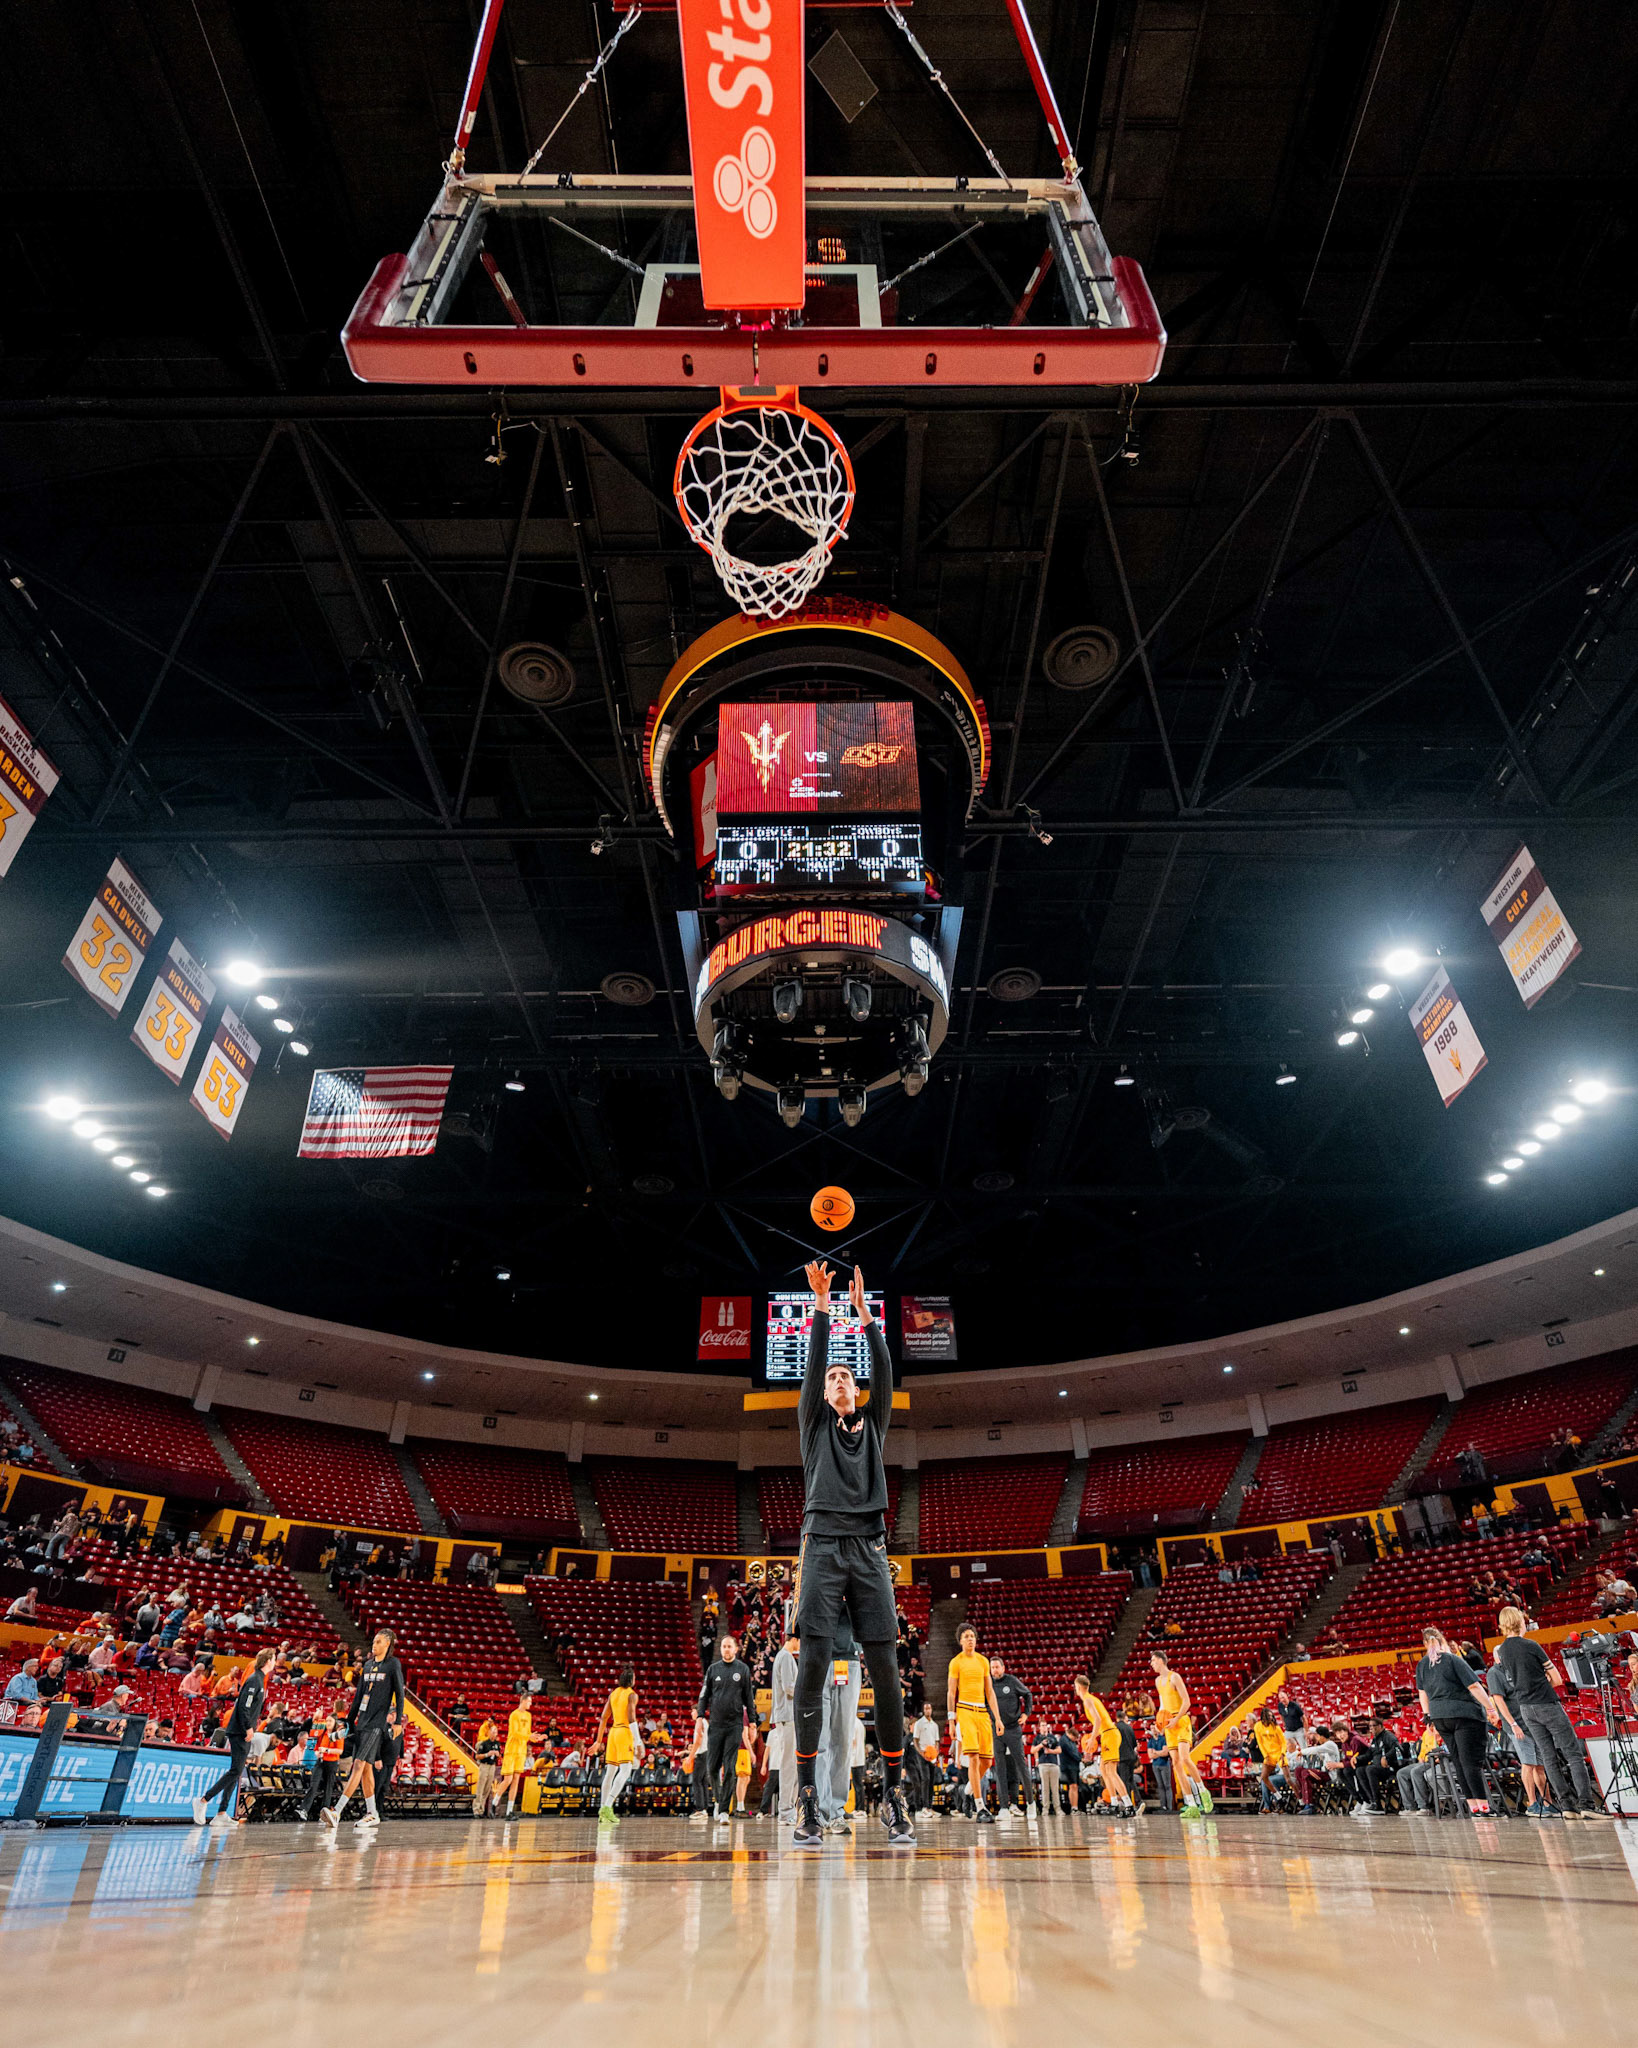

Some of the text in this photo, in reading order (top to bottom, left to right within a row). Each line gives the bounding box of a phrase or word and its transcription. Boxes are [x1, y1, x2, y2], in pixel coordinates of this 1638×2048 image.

[0, 725, 41, 780] BASKETBALL
[13, 729, 37, 760] MEN'S
[739, 841, 758, 859] 0
[787, 841, 852, 858] 21:32
[881, 838, 900, 857] 0
[118, 881, 149, 922] BASKETBALL
[129, 882, 146, 906] MEN'S
[1492, 867, 1522, 907] WRESTLING
[103, 887, 147, 947] CALDWELL
[1506, 889, 1529, 923] CULP
[1508, 905, 1554, 962] NATIONAL
[1511, 912, 1563, 978] CHAMPION
[80, 913, 133, 996] 32
[1520, 928, 1567, 985] HEAVYWEIGHT
[168, 969, 202, 1012] HOLLINS
[1417, 981, 1440, 1013] WRESTLING
[146, 991, 194, 1060] 33
[1422, 994, 1447, 1029] NATIONAL
[1423, 998, 1454, 1041] CHAMPIONS
[223, 1036, 247, 1070] LISTER
[228, 1021, 251, 1054] BASKETBALL
[1434, 1020, 1458, 1055] 1988
[203, 1055, 241, 1118] 53
[781, 1305, 793, 1318] 0
